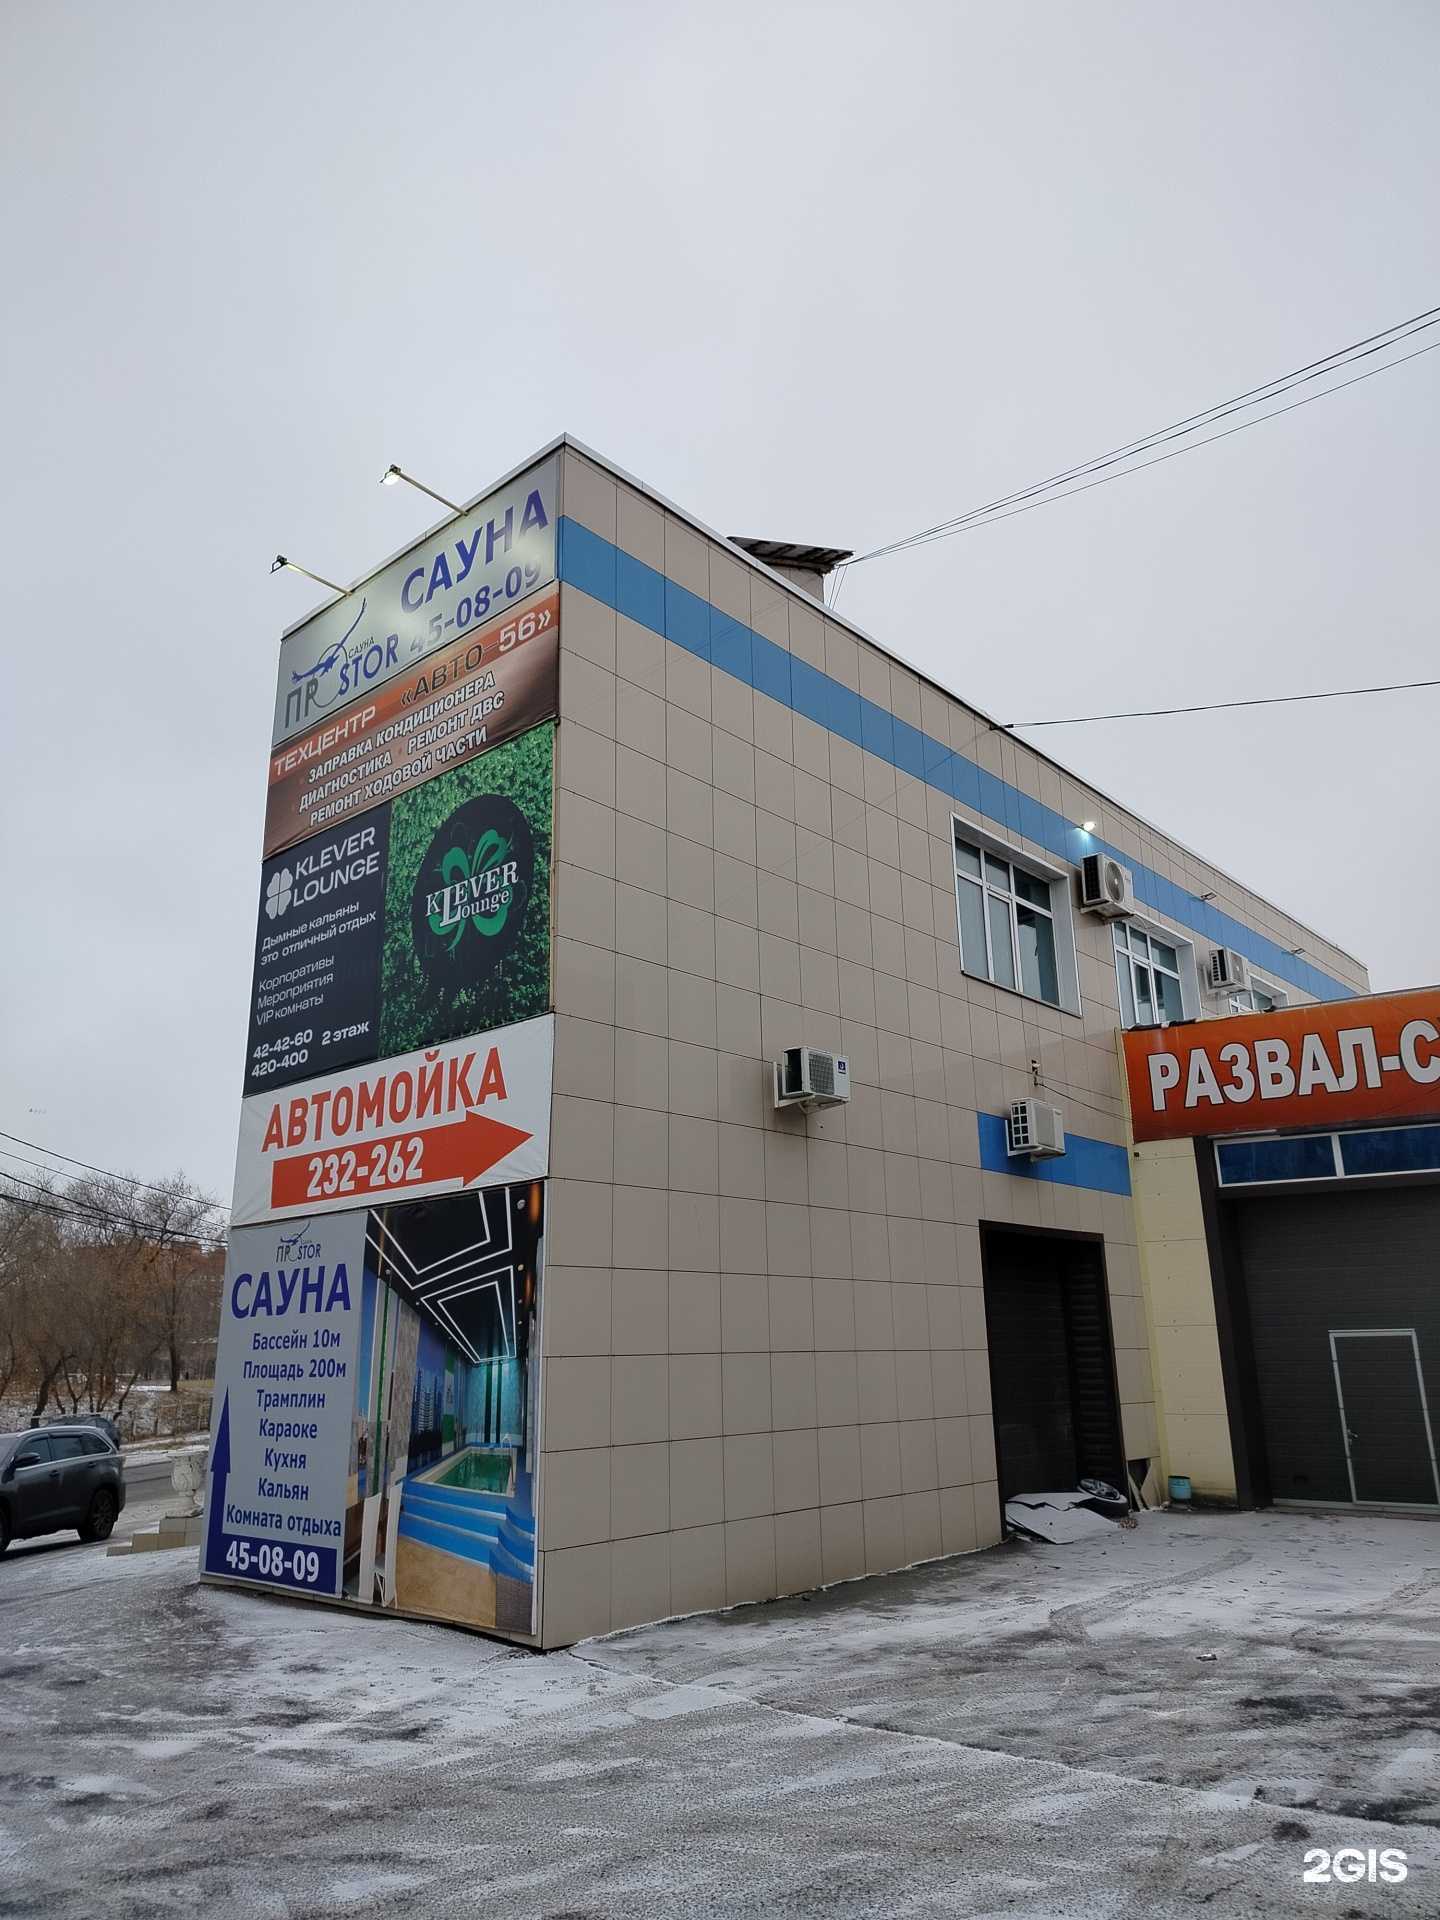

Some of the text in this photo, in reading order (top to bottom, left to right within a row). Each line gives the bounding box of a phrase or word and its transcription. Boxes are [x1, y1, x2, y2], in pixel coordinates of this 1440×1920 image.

[401, 489, 548, 613] САУНА
[410, 557, 542, 653] 45-08-09
[274, 705, 376, 776] ТЕХЦЕНТР
[299, 691, 504, 814] ДИАГНОСТИКА РЕМОНТ ДВС
[308, 671, 496, 784] ЗАПРАВКА КОНДИЦИОНЕРА
[310, 725, 487, 827] РЕМОНТ ХОДОВОЙ ЧАСТИ
[293, 851, 380, 907] LOUNGE
[295, 826, 376, 880] KLEVER
[425, 861, 519, 928] KLEVER
[261, 902, 360, 952] Дымные кальяны
[261, 911, 377, 965] это отличный отдых
[257, 973, 334, 1010] Мероприятия
[259, 955, 335, 992] Корпоративы
[256, 994, 324, 1025] VIP комнаты
[251, 1049, 308, 1077] 420-400
[253, 1021, 370, 1060] 42-42-60 2 этаж
[1148, 1019, 1440, 1111] РАЗВАЛ-С
[262, 1046, 507, 1152] АВТОМОЙКА
[307, 1137, 424, 1198] 232-262
[231, 1264, 351, 1319] САУНА
[253, 1329, 340, 1350] Бассейн 10м
[243, 1359, 346, 1381] Площадь 200м
[257, 1389, 326, 1411] Трамплин
[259, 1418, 318, 1442] Караоке
[264, 1448, 307, 1472] Кухня
[258, 1477, 309, 1501] Кальян
[226, 1504, 341, 1537] Комната отдыха
[226, 1540, 319, 1583] 45-08-09
